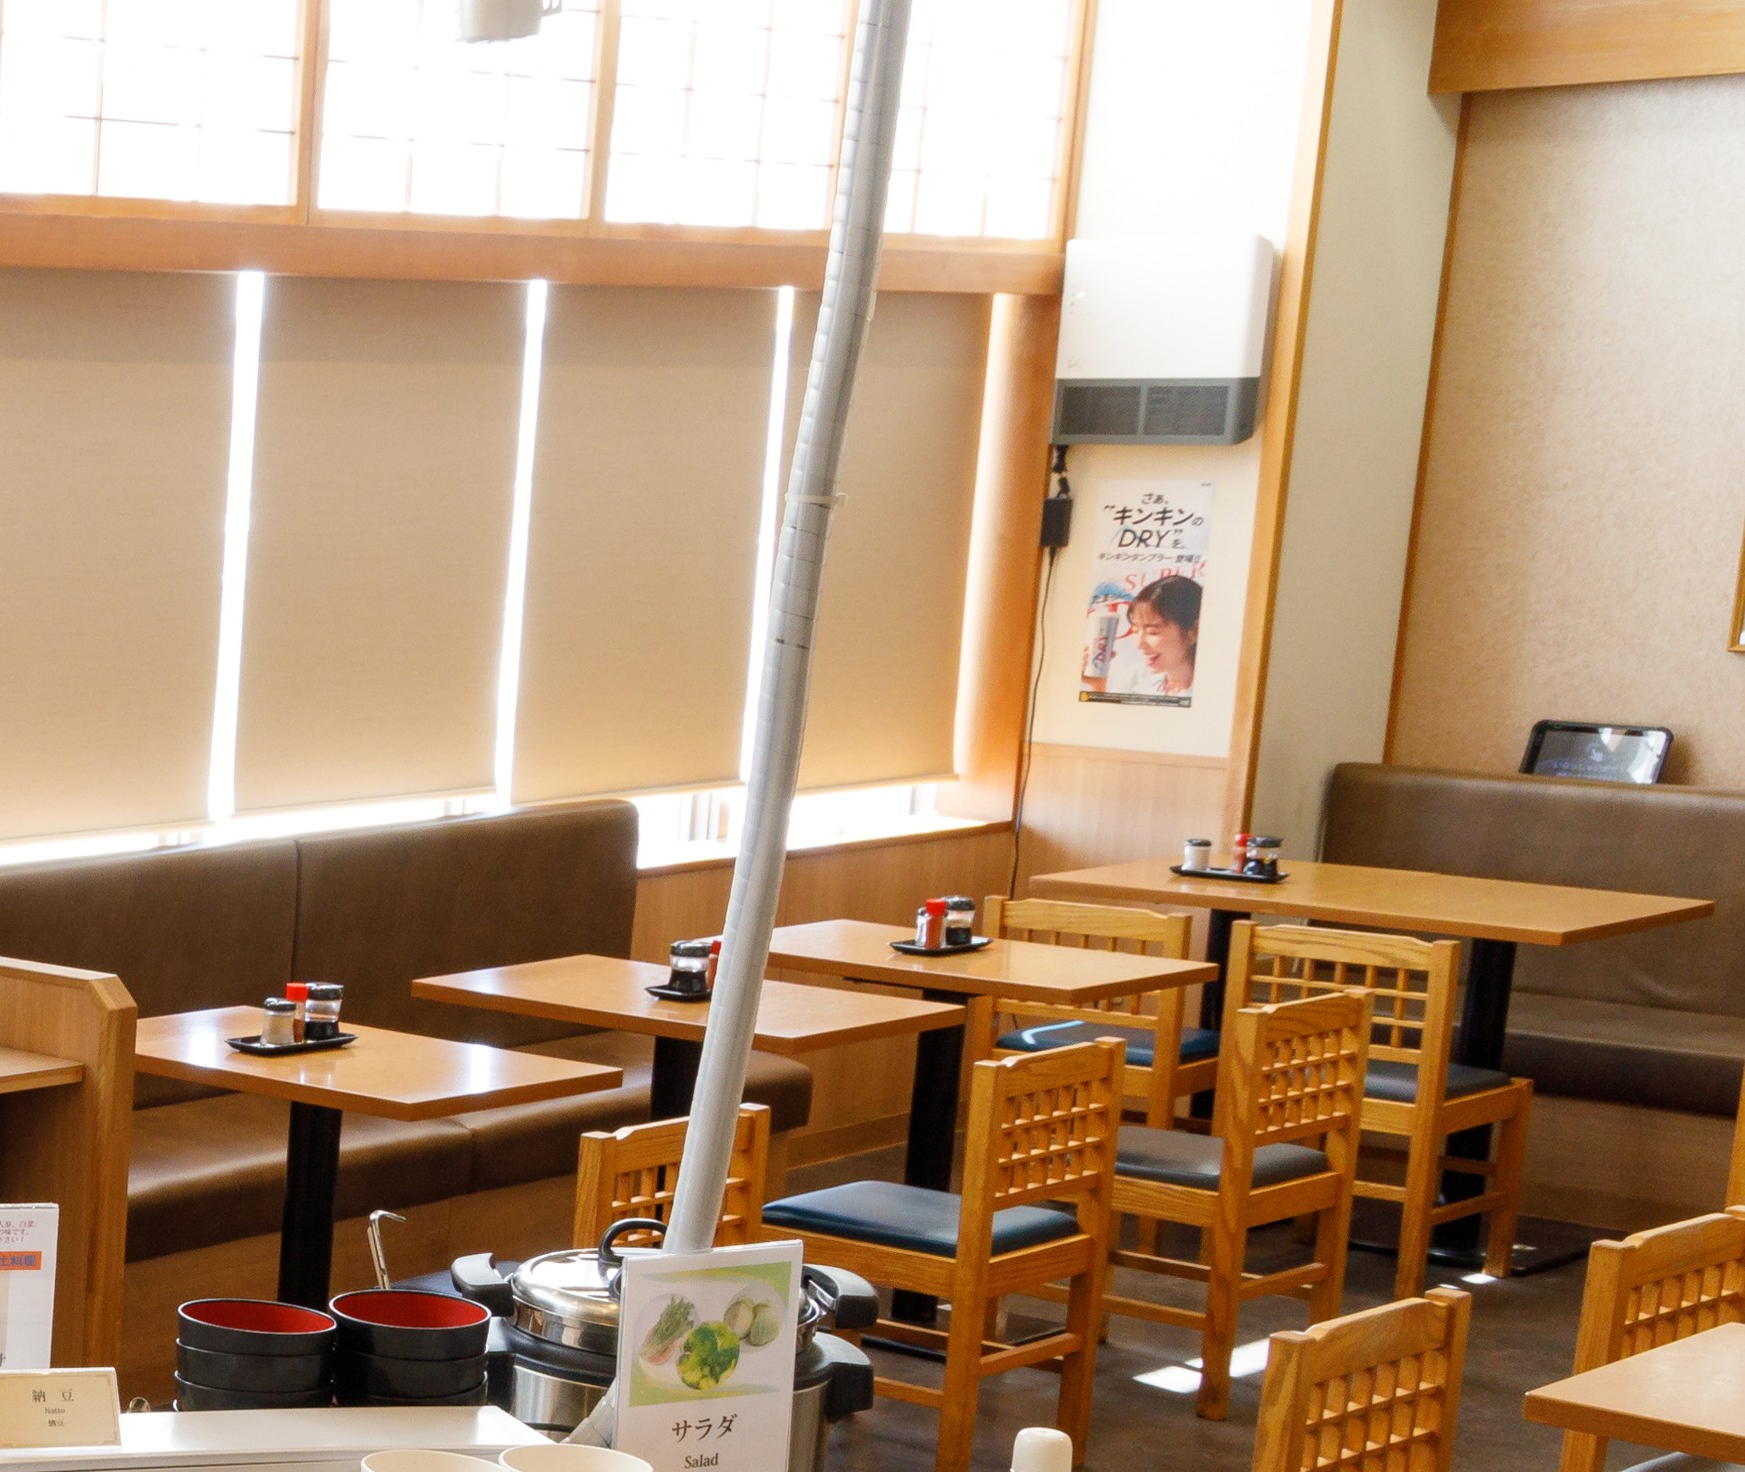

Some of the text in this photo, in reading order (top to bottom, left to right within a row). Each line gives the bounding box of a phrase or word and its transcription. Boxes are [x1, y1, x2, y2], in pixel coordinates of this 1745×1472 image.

[45, 1407, 66, 1415] Natto
[671, 1413, 738, 1444] サラダ
[684, 1453, 719, 1470] Salad
